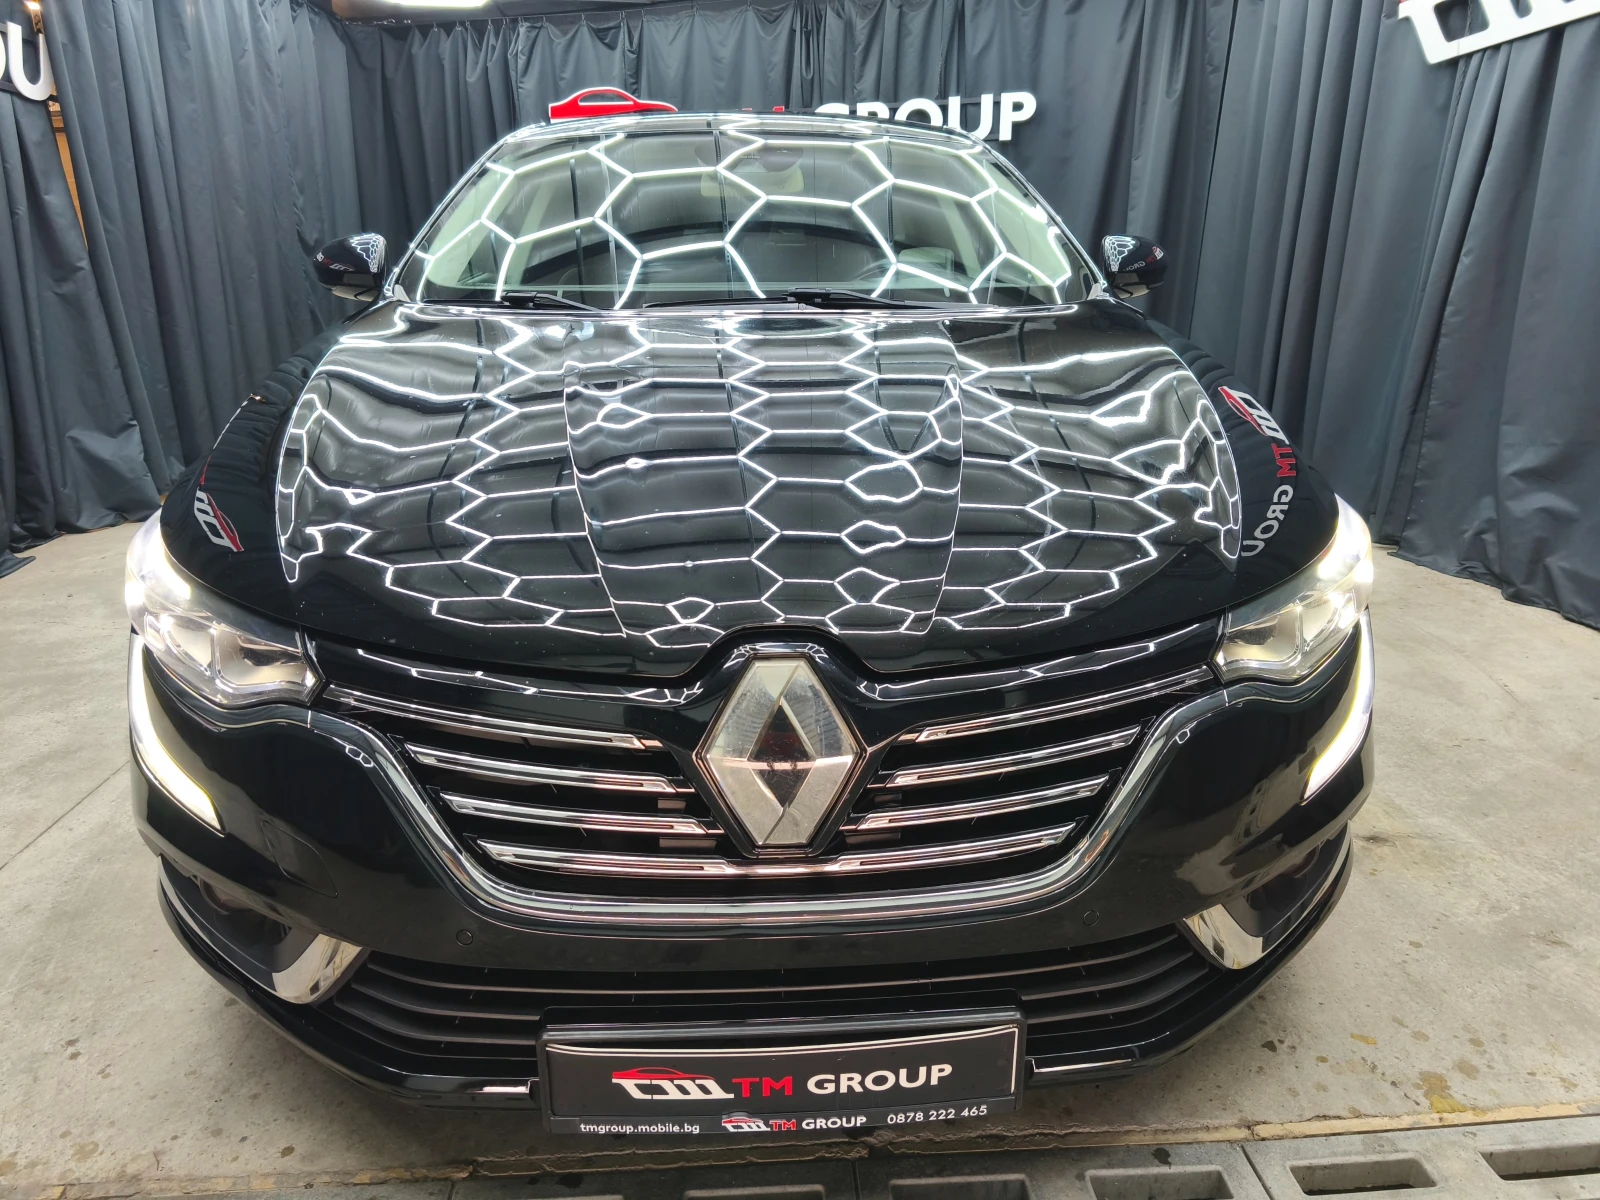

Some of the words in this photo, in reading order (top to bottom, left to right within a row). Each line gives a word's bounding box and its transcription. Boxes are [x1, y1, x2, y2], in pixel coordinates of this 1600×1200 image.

[732, 1076, 793, 1098] TM
[806, 1063, 953, 1095] GROUP
[769, 1119, 797, 1131] TM
[801, 1116, 867, 1130] GROUP
[887, 1111, 924, 1125] 0878
[928, 1108, 956, 1121] 222
[960, 1104, 988, 1118] 465
[580, 1122, 700, 1134] tmgroup.mobile.bg
